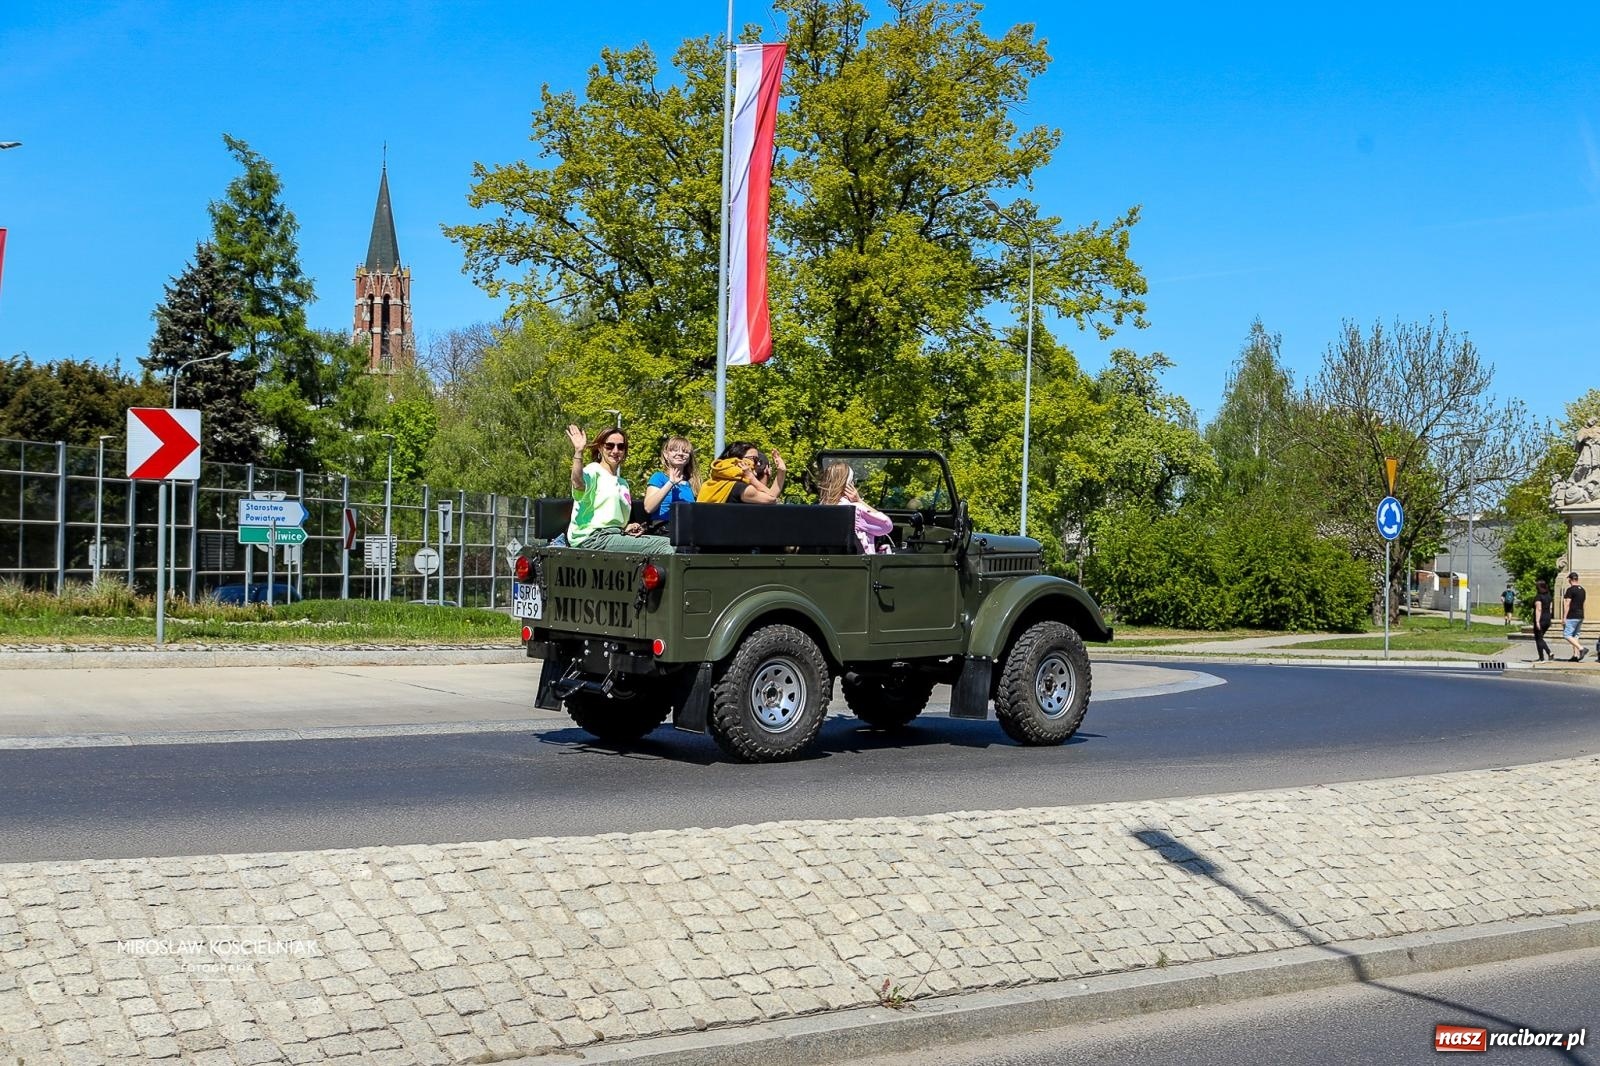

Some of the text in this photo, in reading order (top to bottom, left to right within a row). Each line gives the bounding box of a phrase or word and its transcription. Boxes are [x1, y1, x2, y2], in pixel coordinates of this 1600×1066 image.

[245, 503, 284, 512] Starostwo
[245, 514, 286, 522] Powiatowe
[554, 566, 634, 592] ARO M461
[516, 601, 539, 618] FY59
[553, 597, 633, 629] MUSCEL
